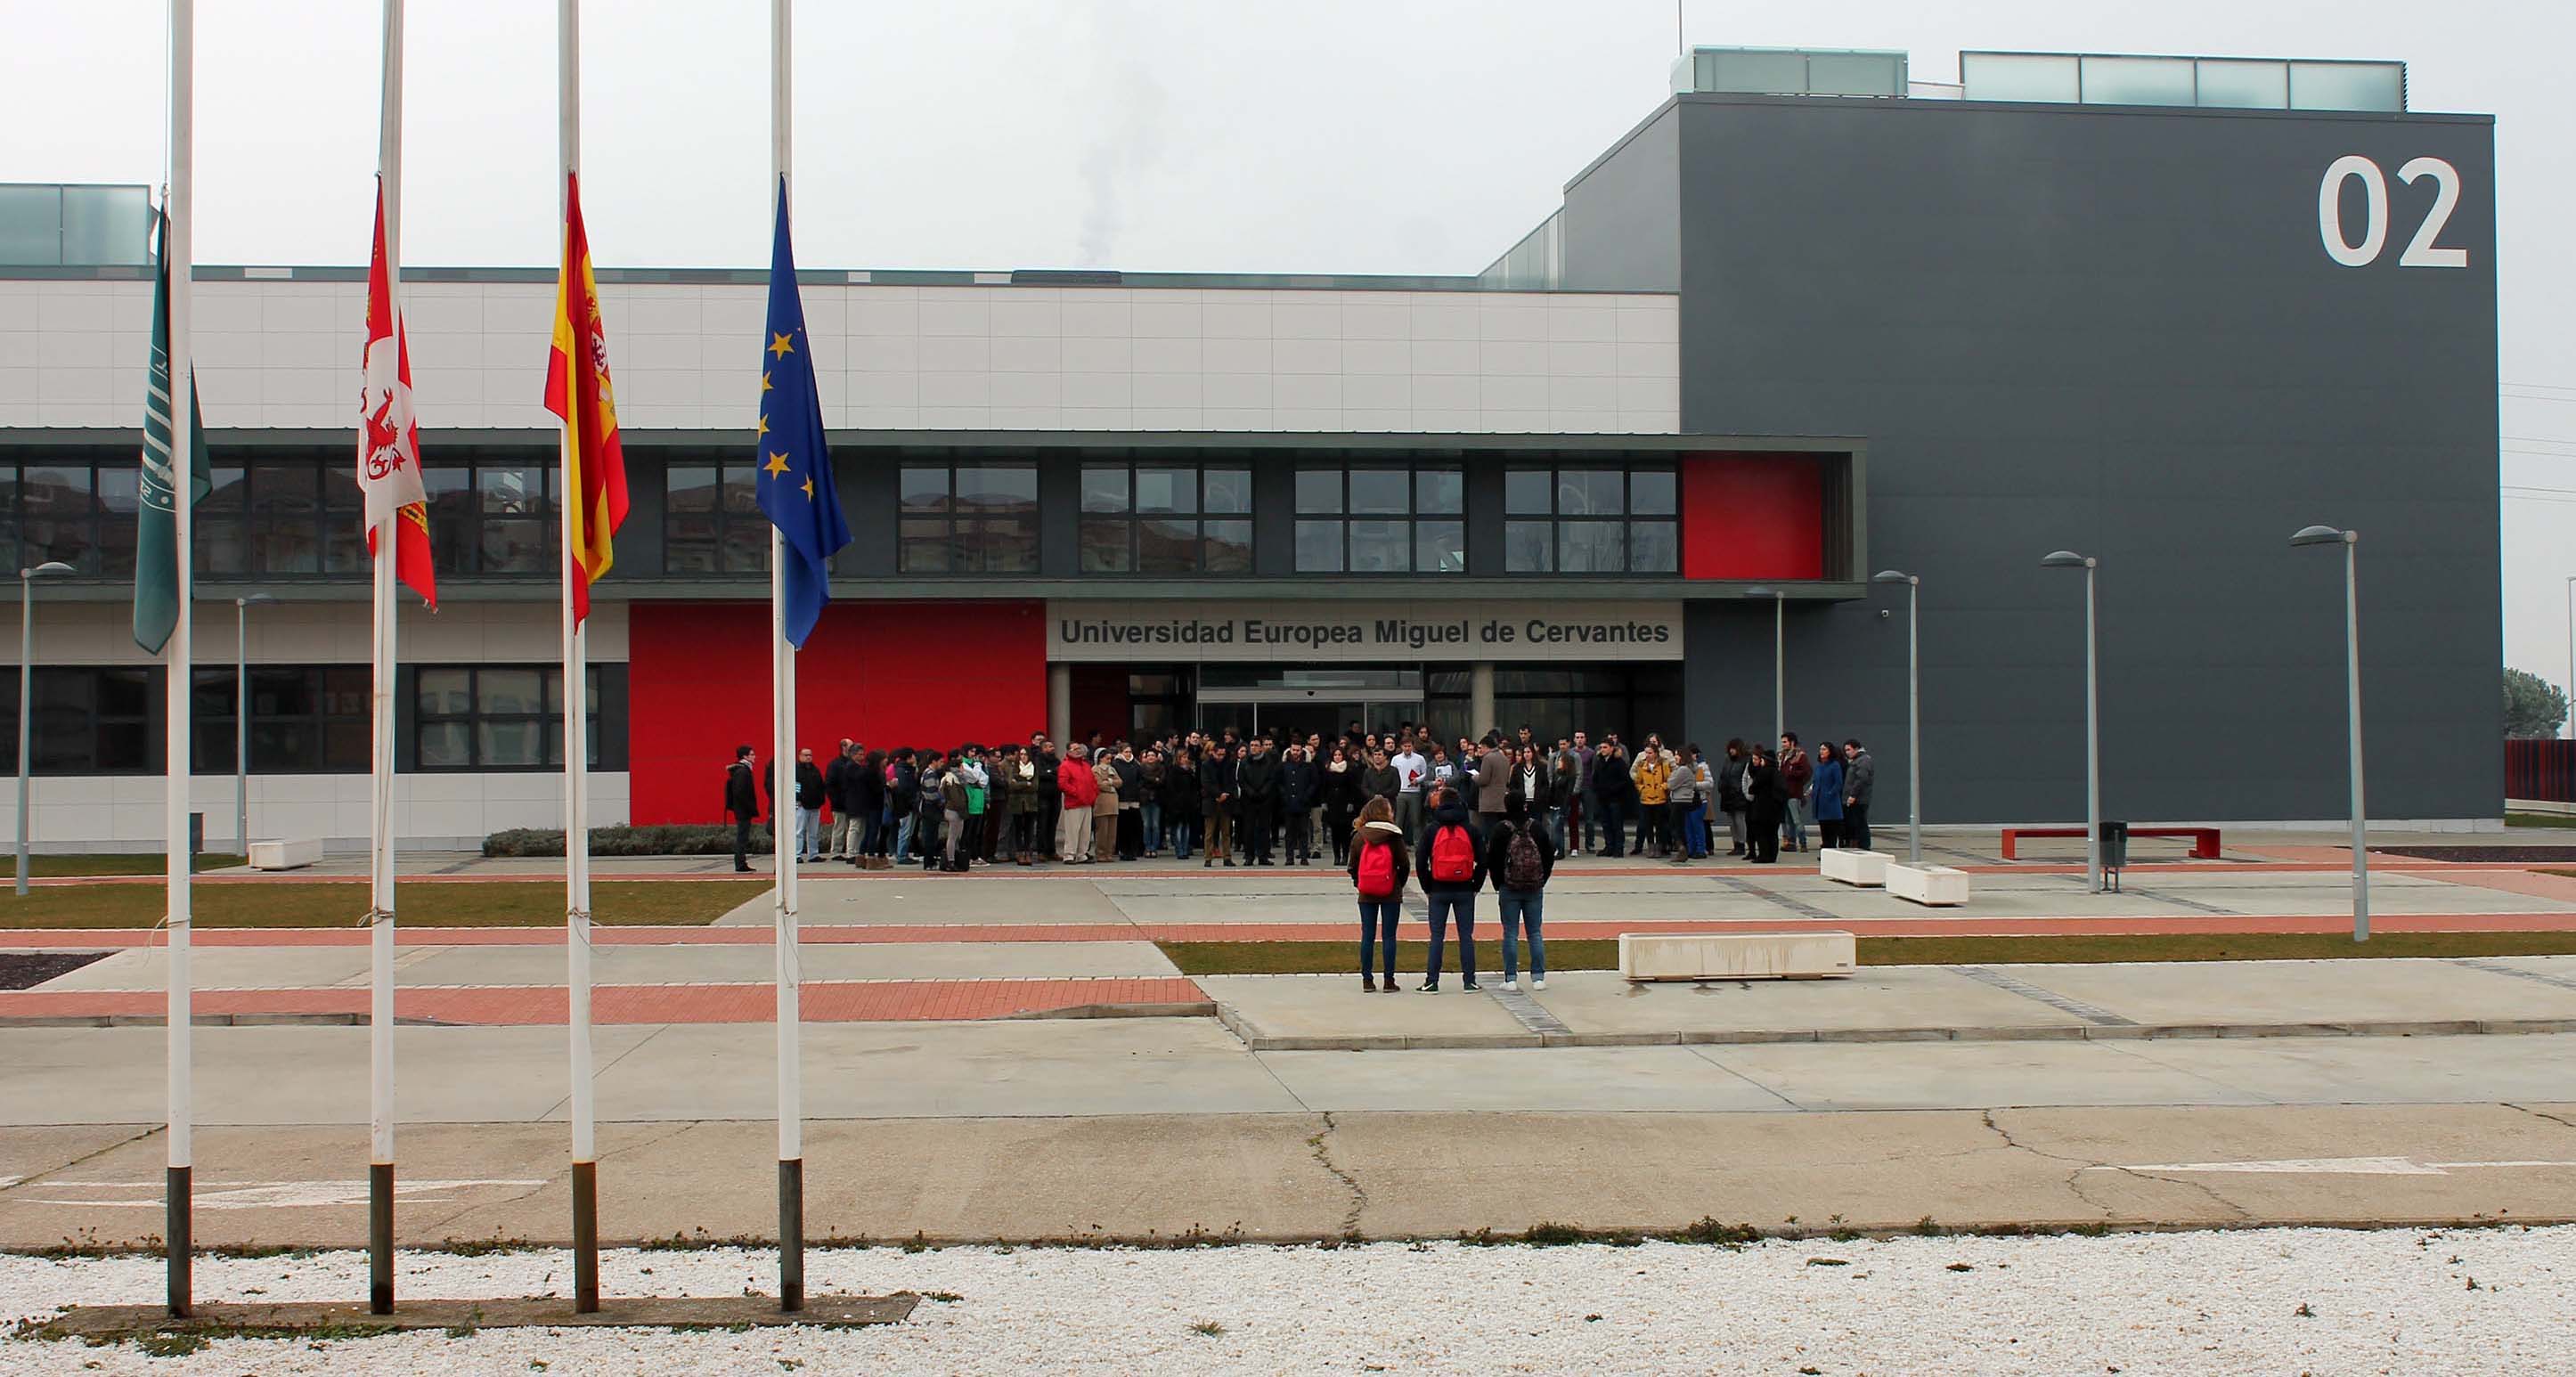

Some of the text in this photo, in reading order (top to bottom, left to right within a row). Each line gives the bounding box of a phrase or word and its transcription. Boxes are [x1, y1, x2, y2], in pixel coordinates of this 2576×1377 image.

[2319, 155, 2467, 268] 02
[1062, 619, 1670, 649] Universidad Europea Miguel de Cervantes
